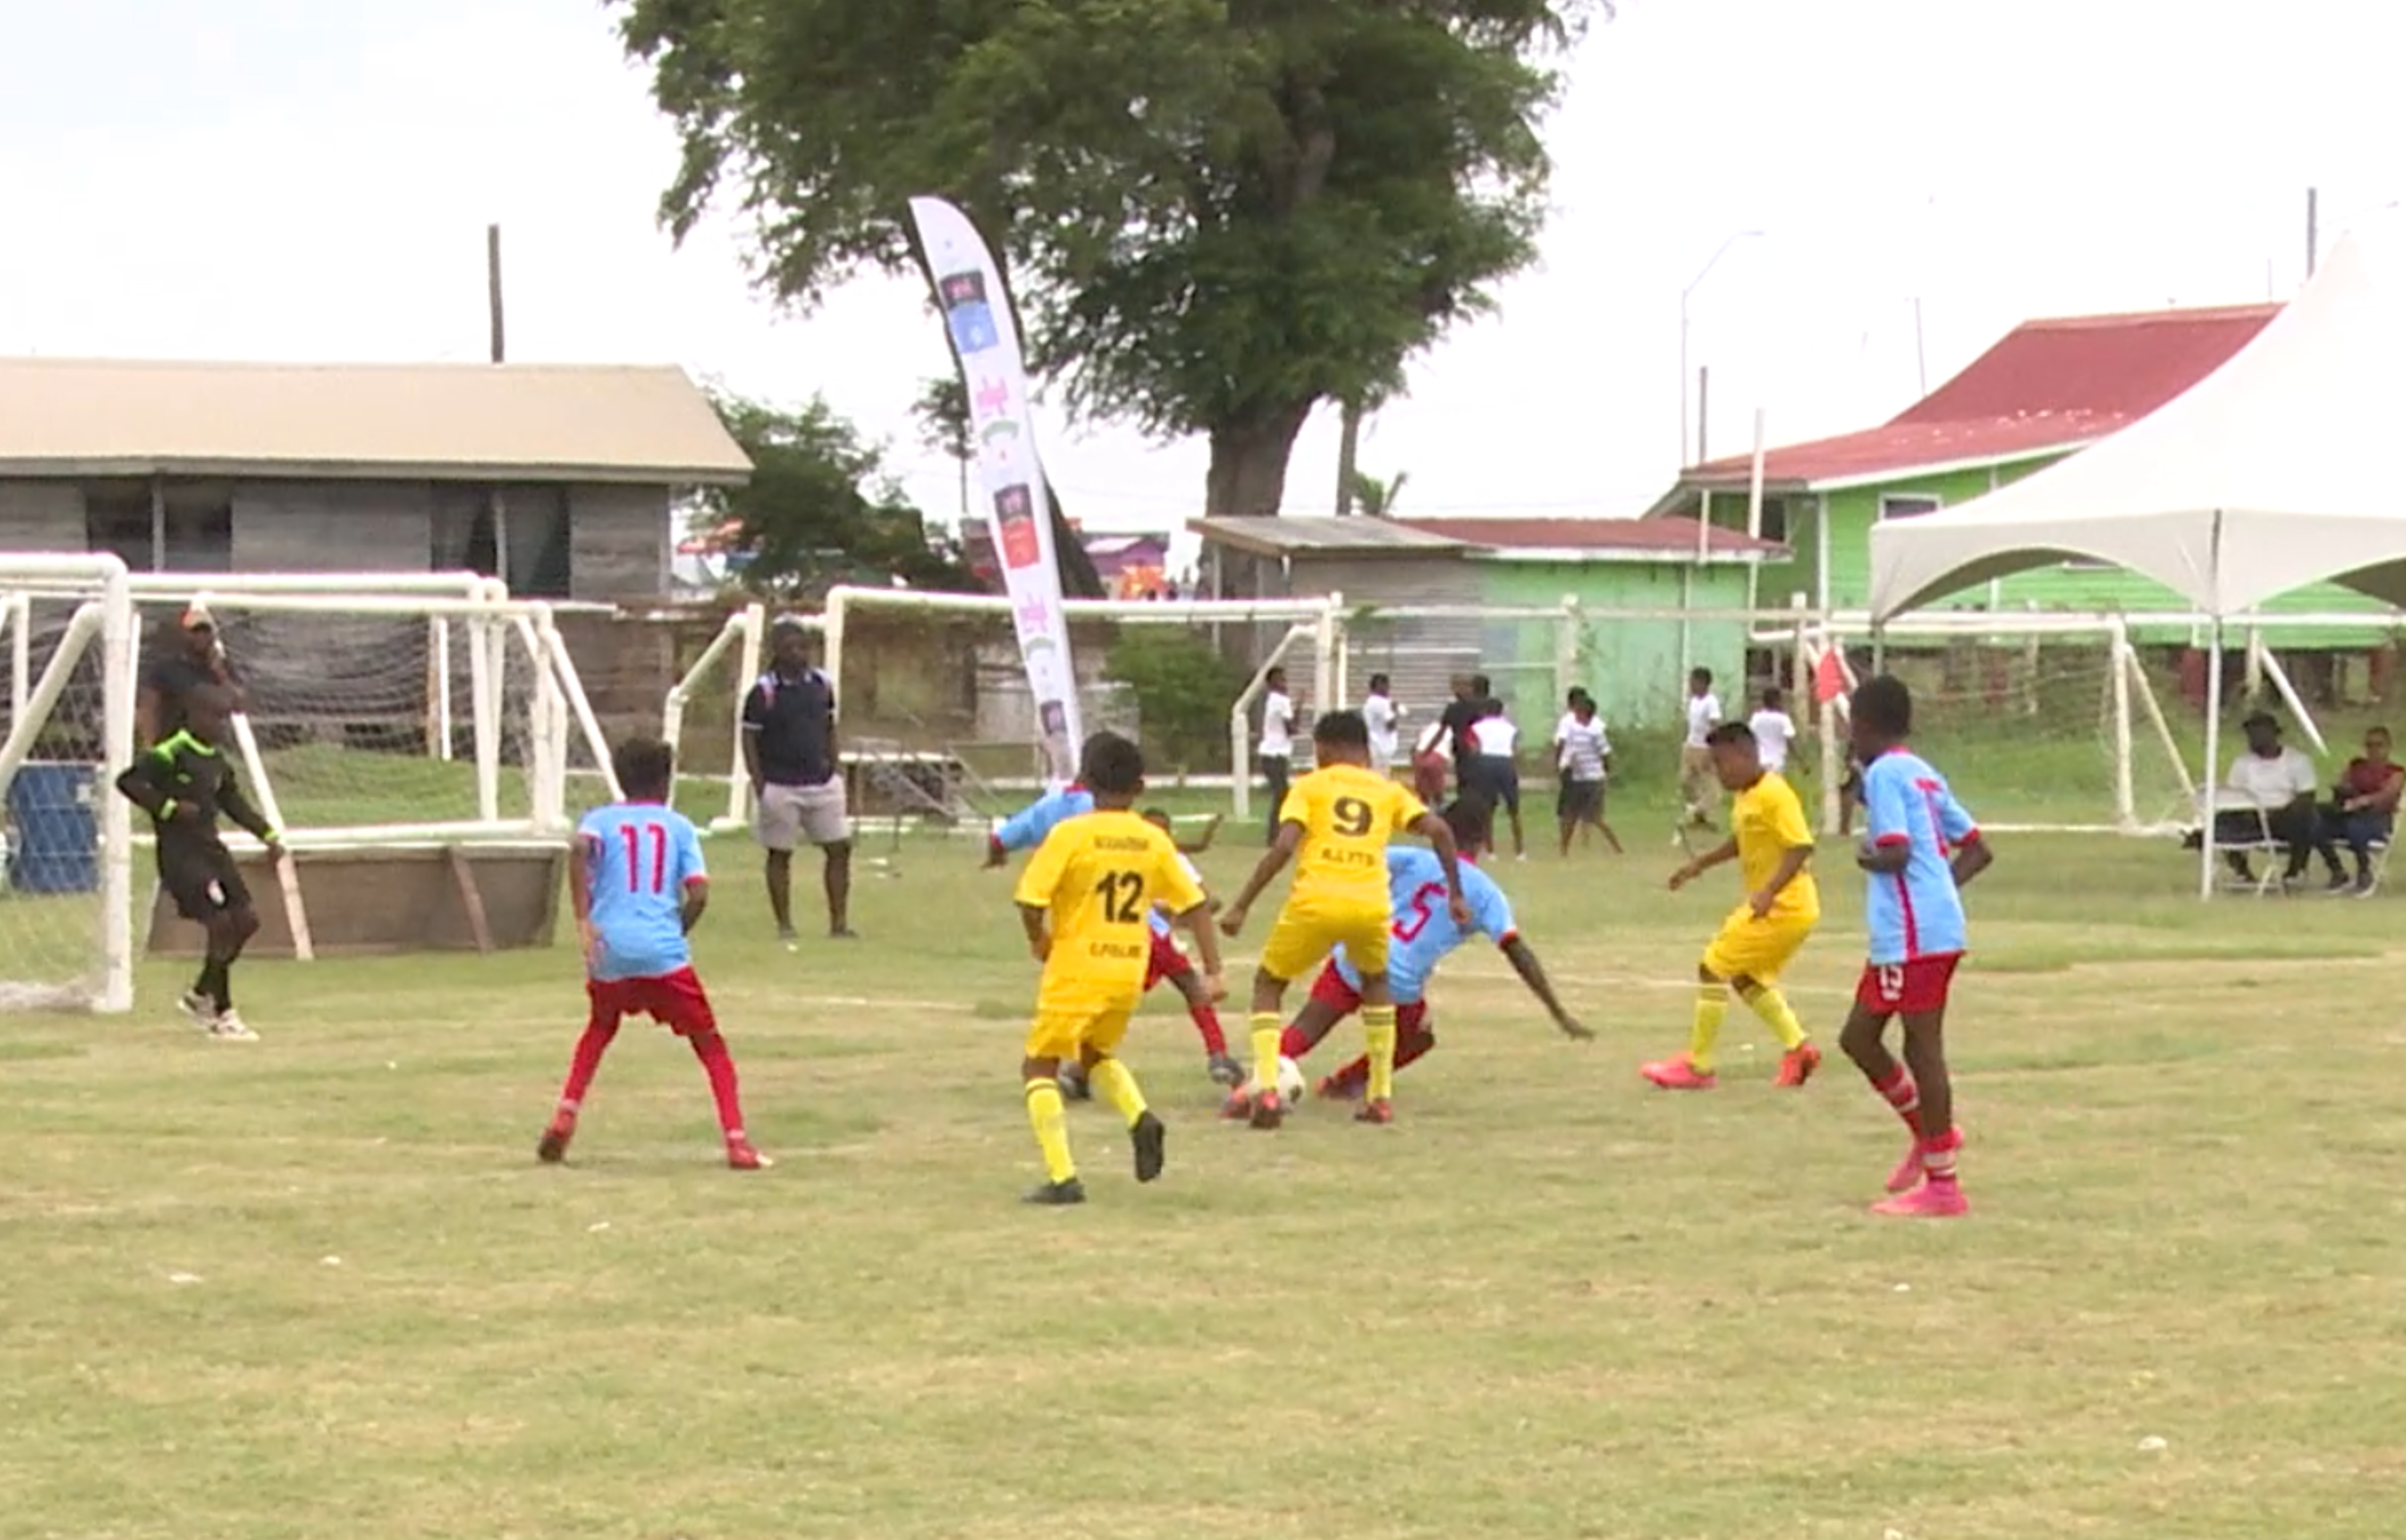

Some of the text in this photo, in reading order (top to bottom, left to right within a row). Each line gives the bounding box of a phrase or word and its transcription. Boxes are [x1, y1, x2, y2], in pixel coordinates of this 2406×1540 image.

[1333, 796, 1373, 837] 9
[619, 824, 665, 894] 11
[1096, 870, 1143, 923] 12
[1391, 881, 1448, 943] 5
